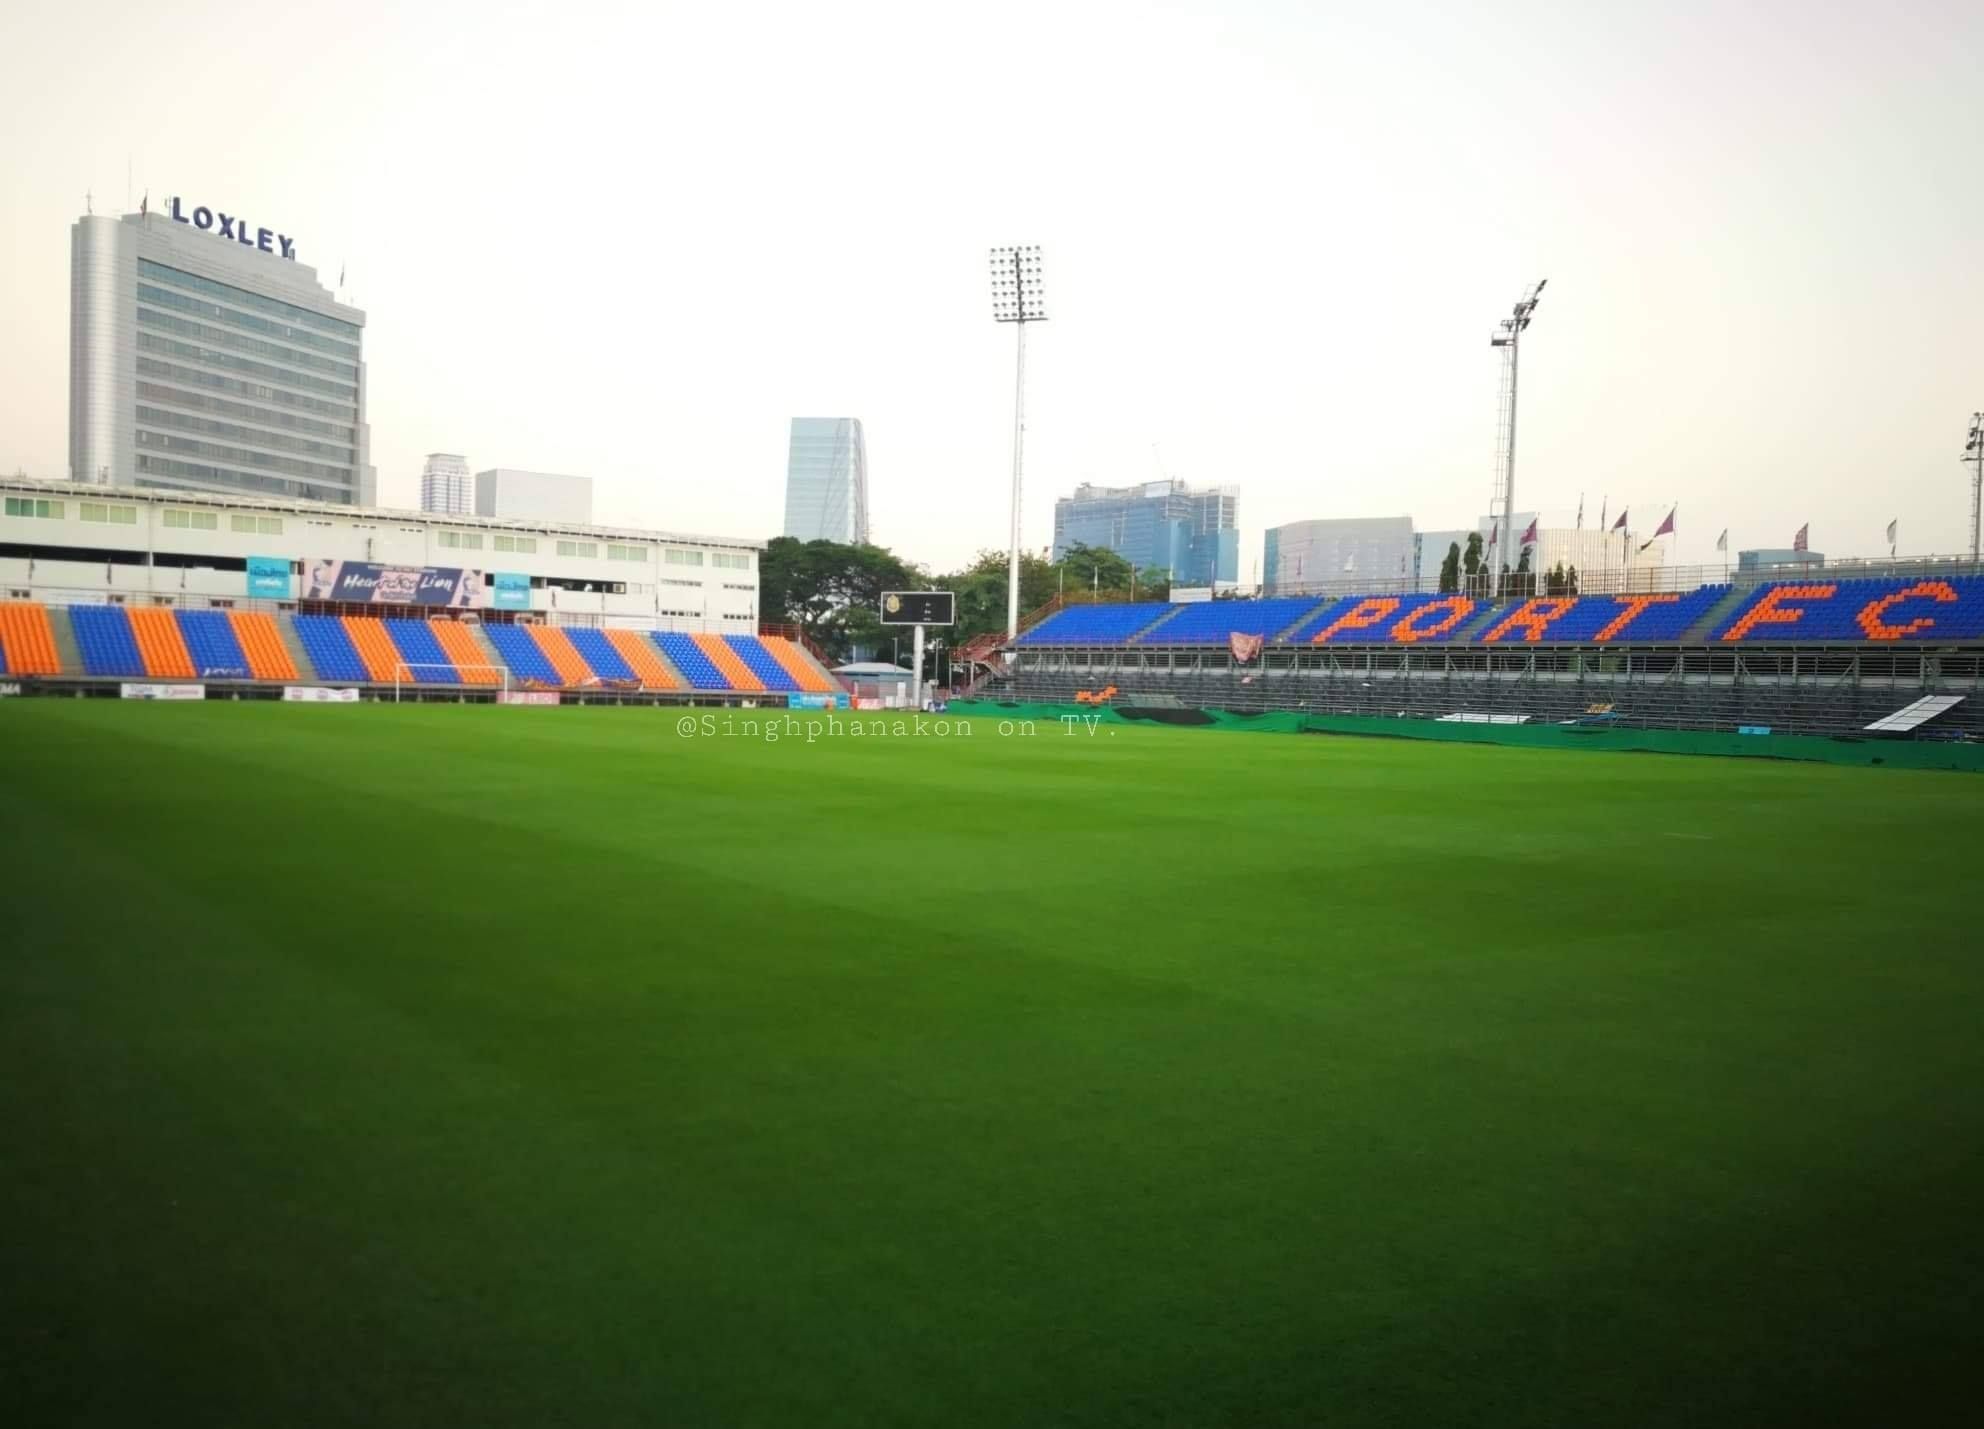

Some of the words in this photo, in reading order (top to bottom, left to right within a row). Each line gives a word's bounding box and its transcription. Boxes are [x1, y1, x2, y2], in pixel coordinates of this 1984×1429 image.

[173, 196, 294, 258] LOXLEY
[1312, 596, 1680, 641] PORT
[1722, 582, 1958, 640] FC
